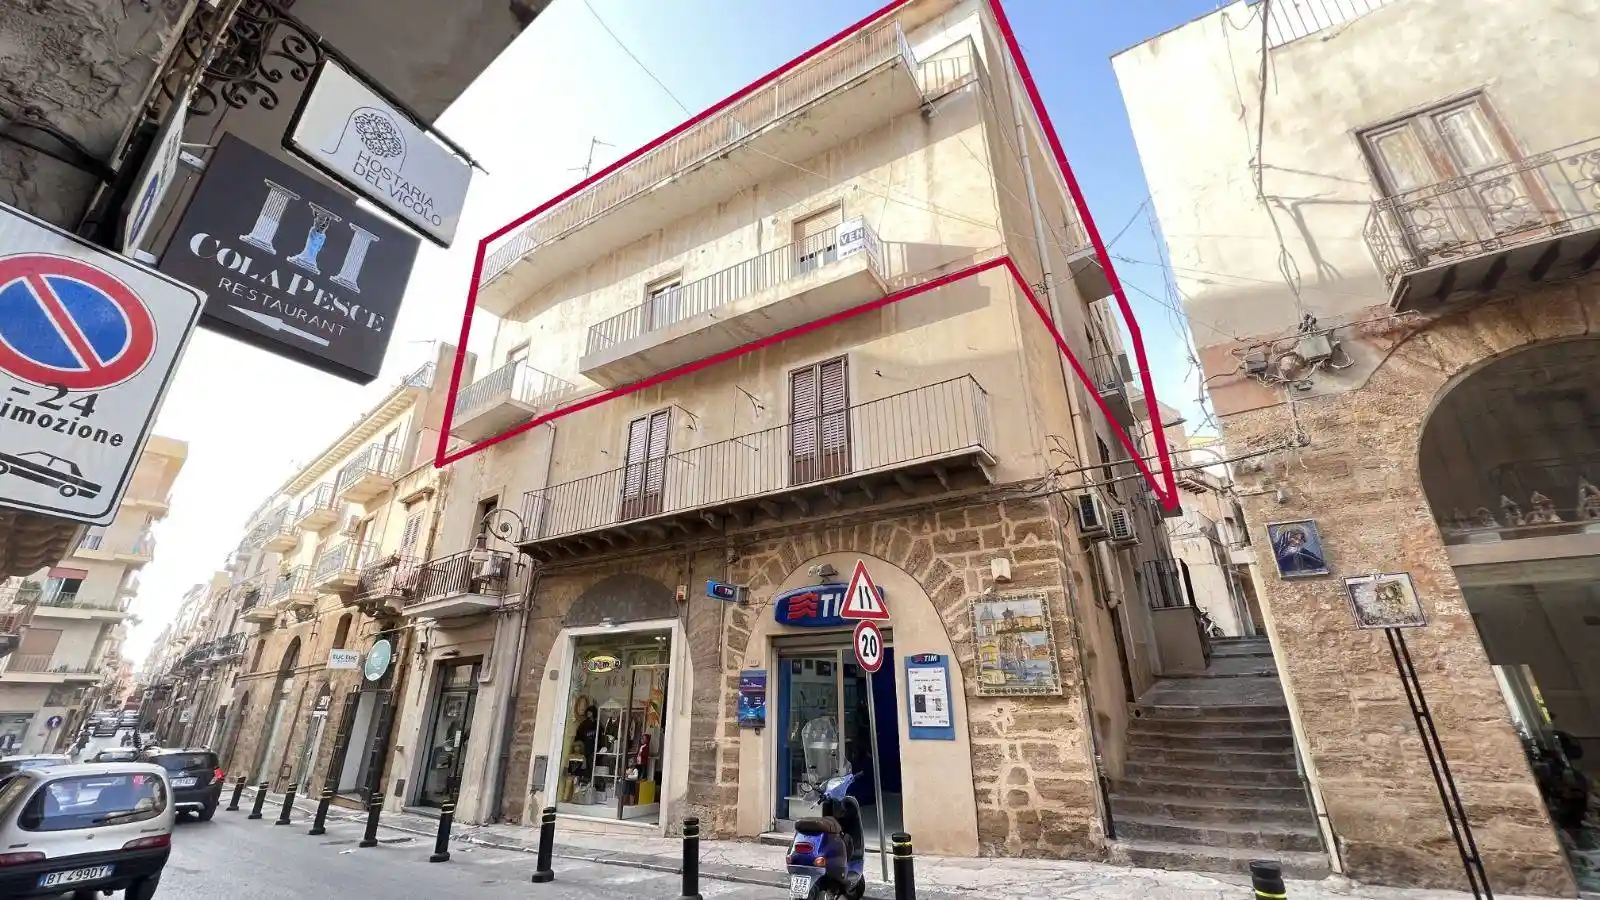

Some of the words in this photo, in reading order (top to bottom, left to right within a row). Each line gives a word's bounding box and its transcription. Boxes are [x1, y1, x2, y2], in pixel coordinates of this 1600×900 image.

[353, 162, 383, 190] DEL
[389, 184, 442, 226] VICOLO
[358, 151, 433, 209] HOSTARIA
[218, 276, 348, 336] RESTAURANT
[821, 593, 841, 618] TI
[862, 634, 877, 657] 20
[46, 872, 64, 884] BT
